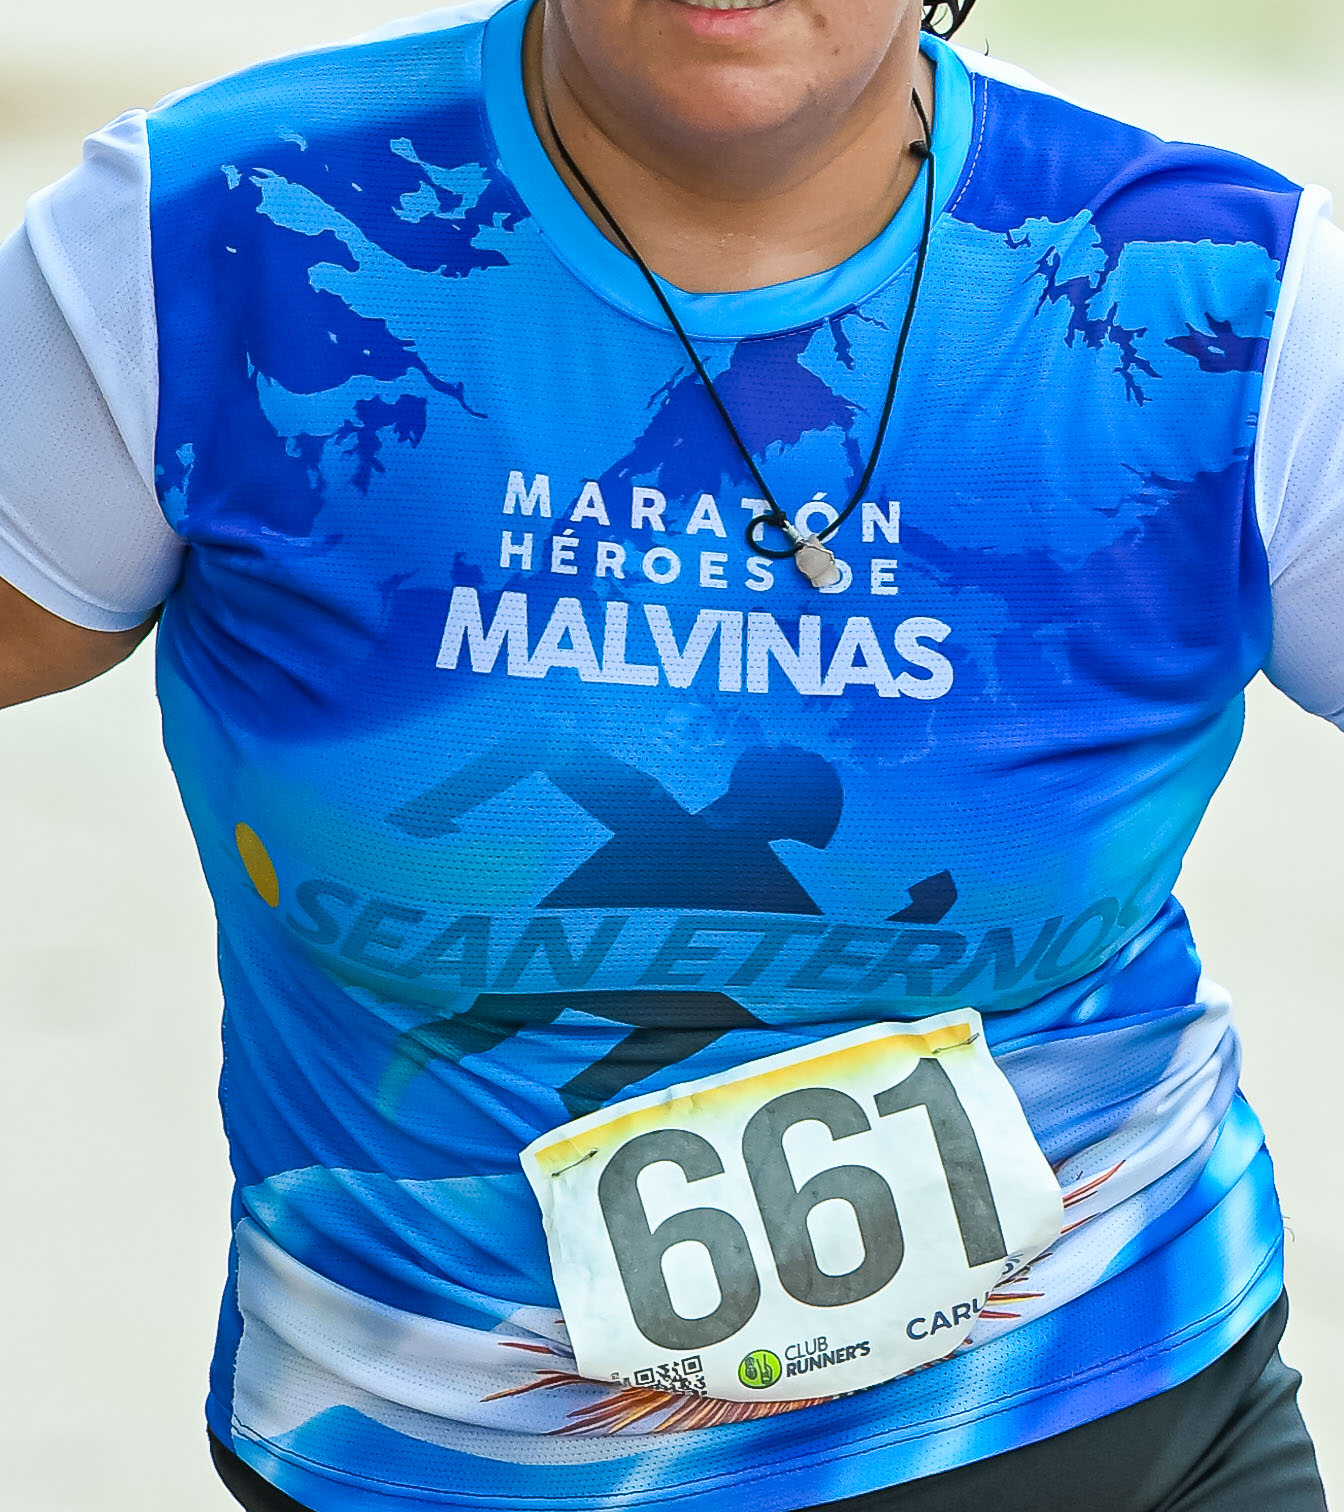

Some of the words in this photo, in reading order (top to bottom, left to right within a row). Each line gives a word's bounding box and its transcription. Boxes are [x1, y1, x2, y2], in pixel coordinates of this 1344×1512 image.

[502, 470, 902, 544] MARATÓN
[499, 529, 775, 593] HÉROES
[435, 586, 955, 701] MALVINAS
[286, 877, 629, 990] SEAN
[597, 1056, 1009, 1351] 661
[784, 1336, 829, 1362] CLUB
[785, 1340, 872, 1378] RUNNER'S
